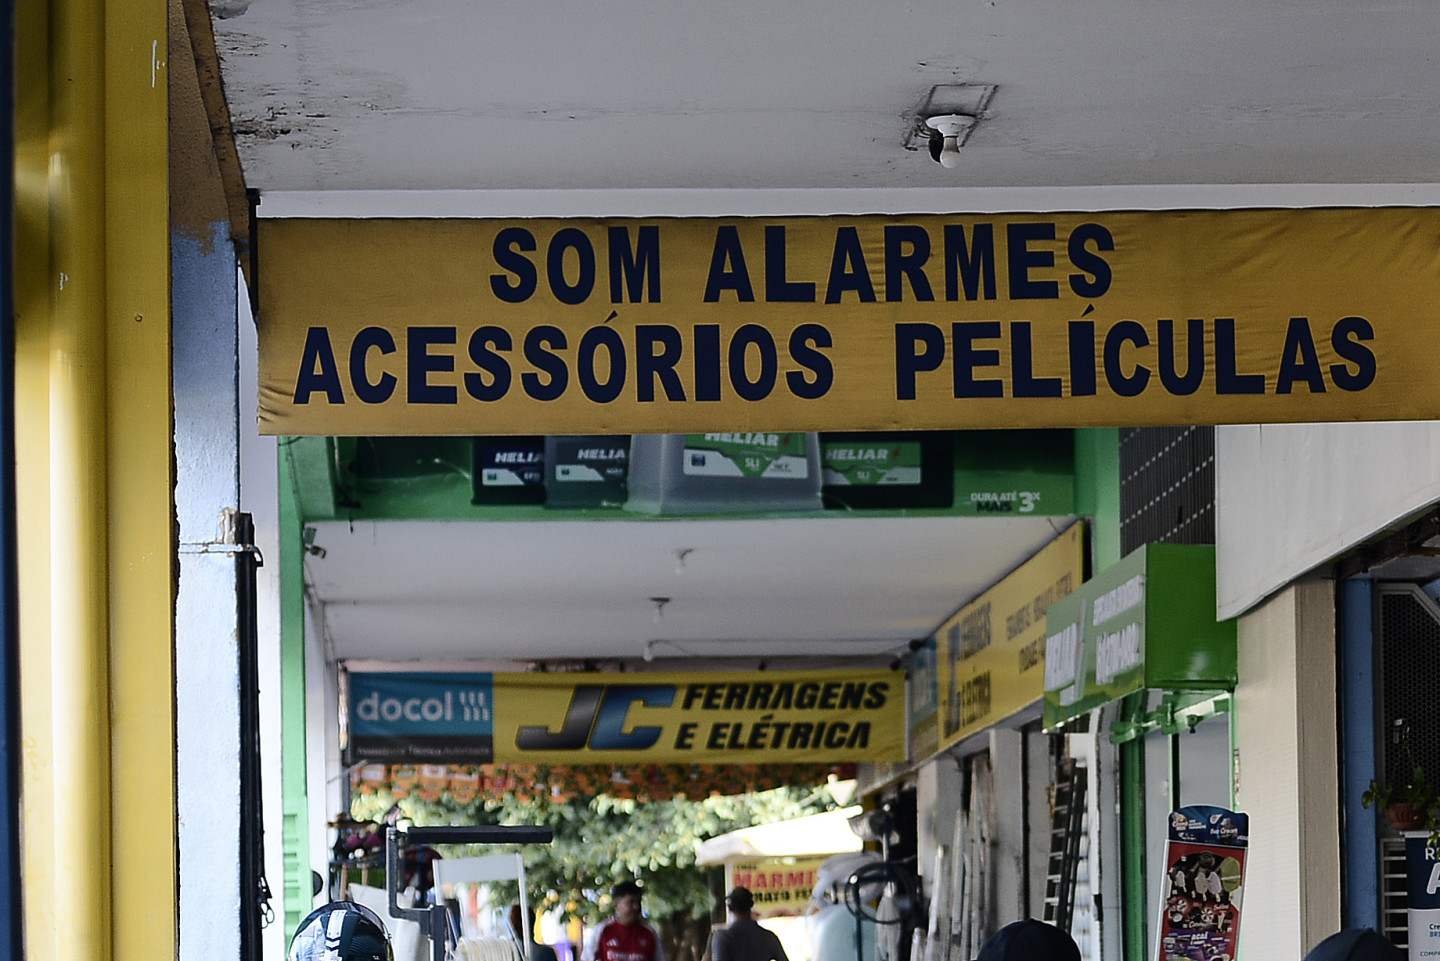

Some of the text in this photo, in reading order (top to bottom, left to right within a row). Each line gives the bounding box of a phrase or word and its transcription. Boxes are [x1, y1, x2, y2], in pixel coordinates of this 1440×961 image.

[489, 222, 1116, 306] SOM ALARMES
[293, 304, 1378, 406] ACESSÓRIOS PELÍCULAS
[824, 448, 890, 461] HELIAR
[356, 690, 454, 722] docol
[681, 681, 890, 713] FERRAGENS
[514, 683, 678, 751] JC
[674, 713, 872, 750] E ELÉTRICA
